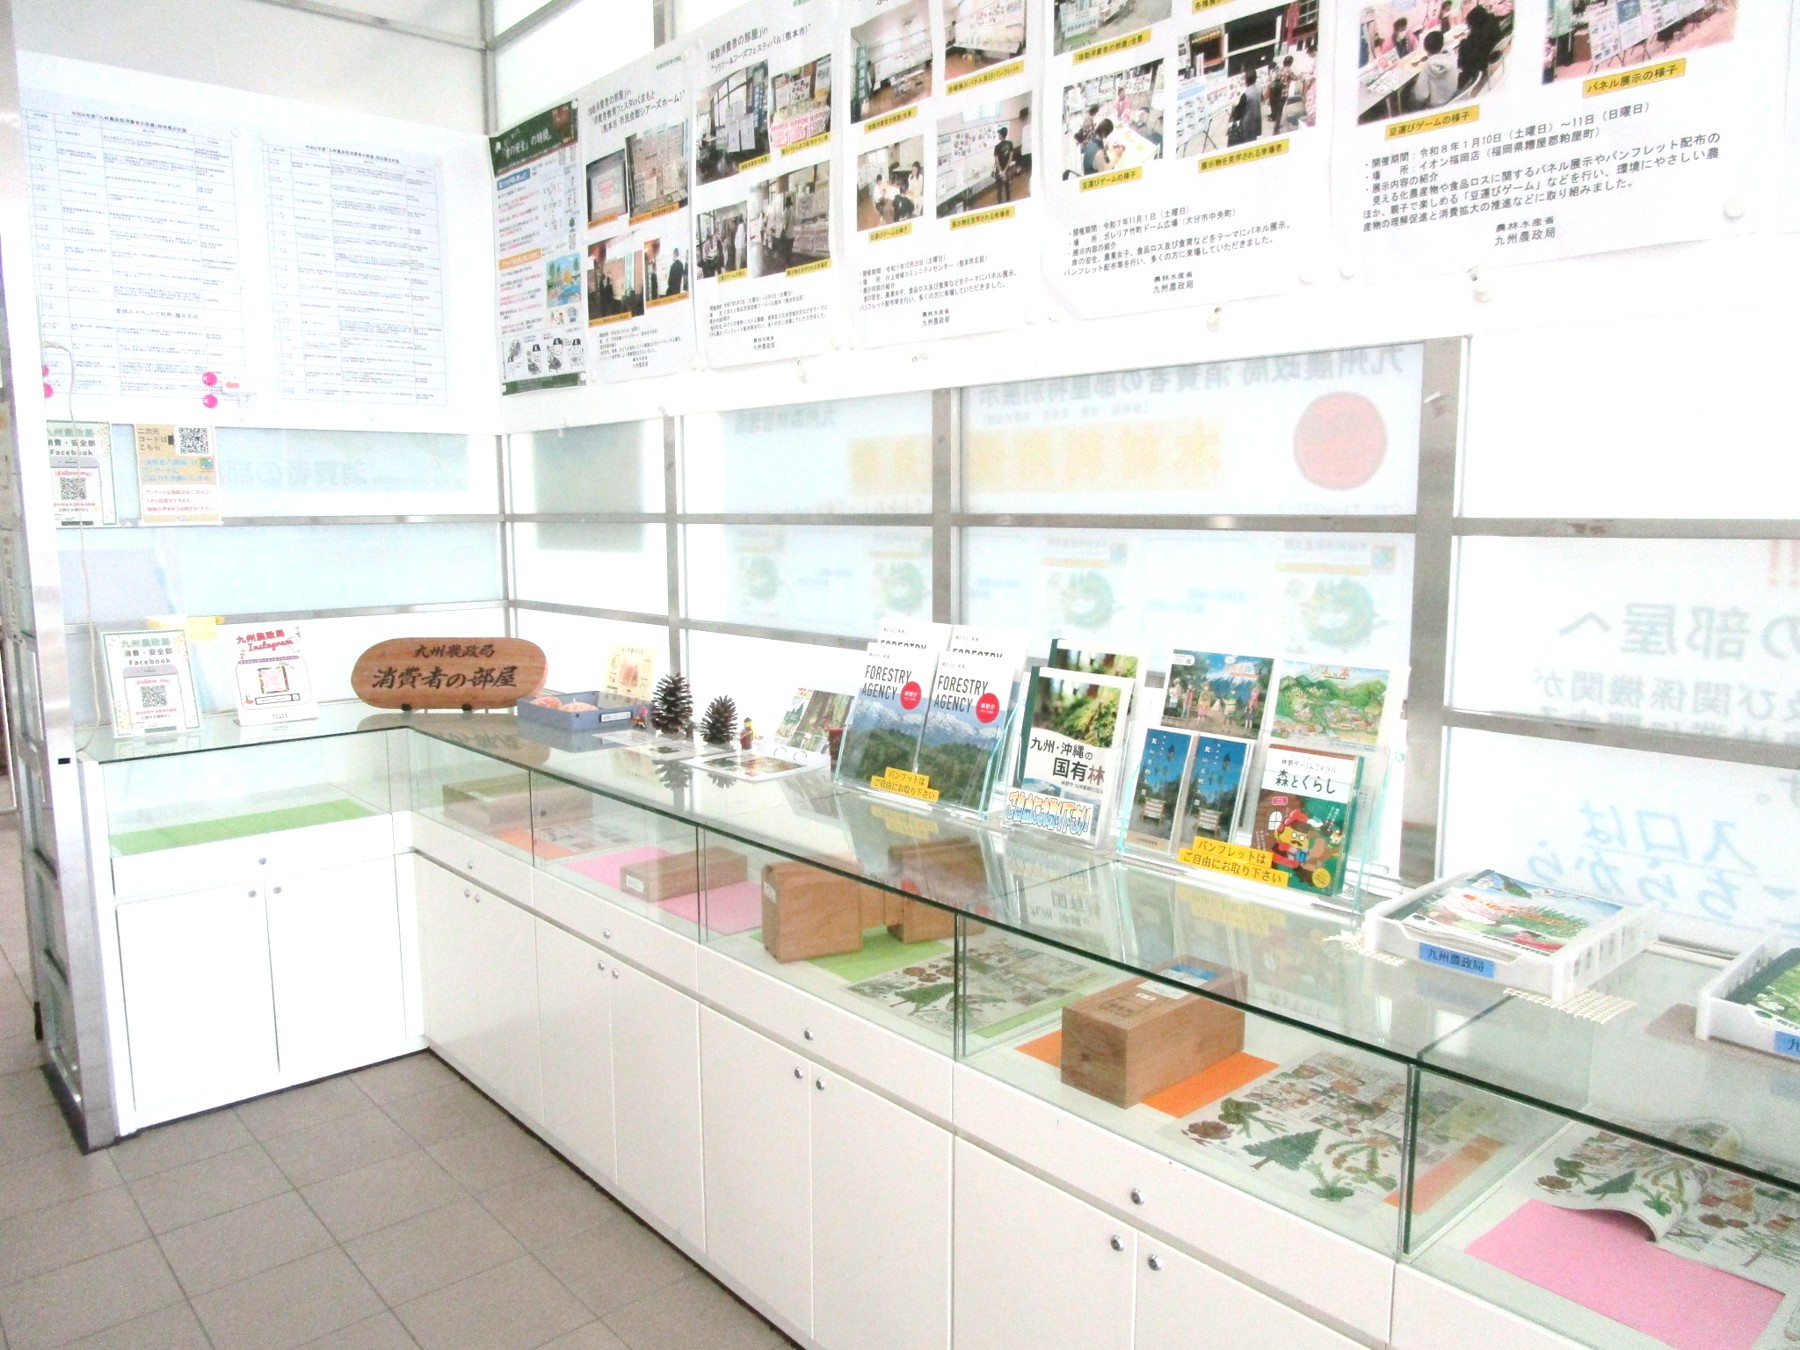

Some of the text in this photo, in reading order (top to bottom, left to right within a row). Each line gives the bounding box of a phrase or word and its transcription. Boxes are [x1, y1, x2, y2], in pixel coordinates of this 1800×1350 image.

[1587, 64, 1677, 93] パネル展示の様子
[1388, 112, 1471, 137] 豆運びゲームの様子
[1373, 132, 1721, 206] 見える化農産物や食品ロスに関するパネル展示やパンフレット配布の
[1363, 147, 1720, 220] ほか、親子で楽しめる「豆運びゲーム」などを行い、環境にやさしい農
[1363, 178, 1633, 232] 産物の理解促進と消費拡大の推進などに取り組みました。
[1496, 216, 1554, 233] 農林水産省
[1494, 227, 1555, 246] 九州農政局
[1152, 280, 1194, 295] 九州農政局
[1153, 271, 1193, 283] 農林水産省
[121, 637, 171, 649] 九州農政局
[236, 629, 285, 645] 九州農政局
[248, 638, 295, 653] Instagram
[124, 648, 173, 658] 消費・安全部
[128, 657, 172, 666] Facebook
[413, 644, 496, 659] 九州農政局
[372, 665, 518, 690] 消費者の部屋
[865, 664, 913, 684] FORESTRY
[861, 682, 898, 701] AGENCY
[937, 675, 989, 696] FORESTRY
[934, 694, 973, 714] AGENCY
[1030, 737, 1093, 760] 九州・沖縄の
[1052, 757, 1105, 786] 国有林
[1275, 769, 1336, 794] 森とくらし
[874, 778, 935, 800] ご自由にお取り下さい
[1198, 840, 1267, 864] パンフレットは
[1183, 852, 1282, 883] ご自由にお取り下さい
[1427, 948, 1485, 973] 九州農政局
